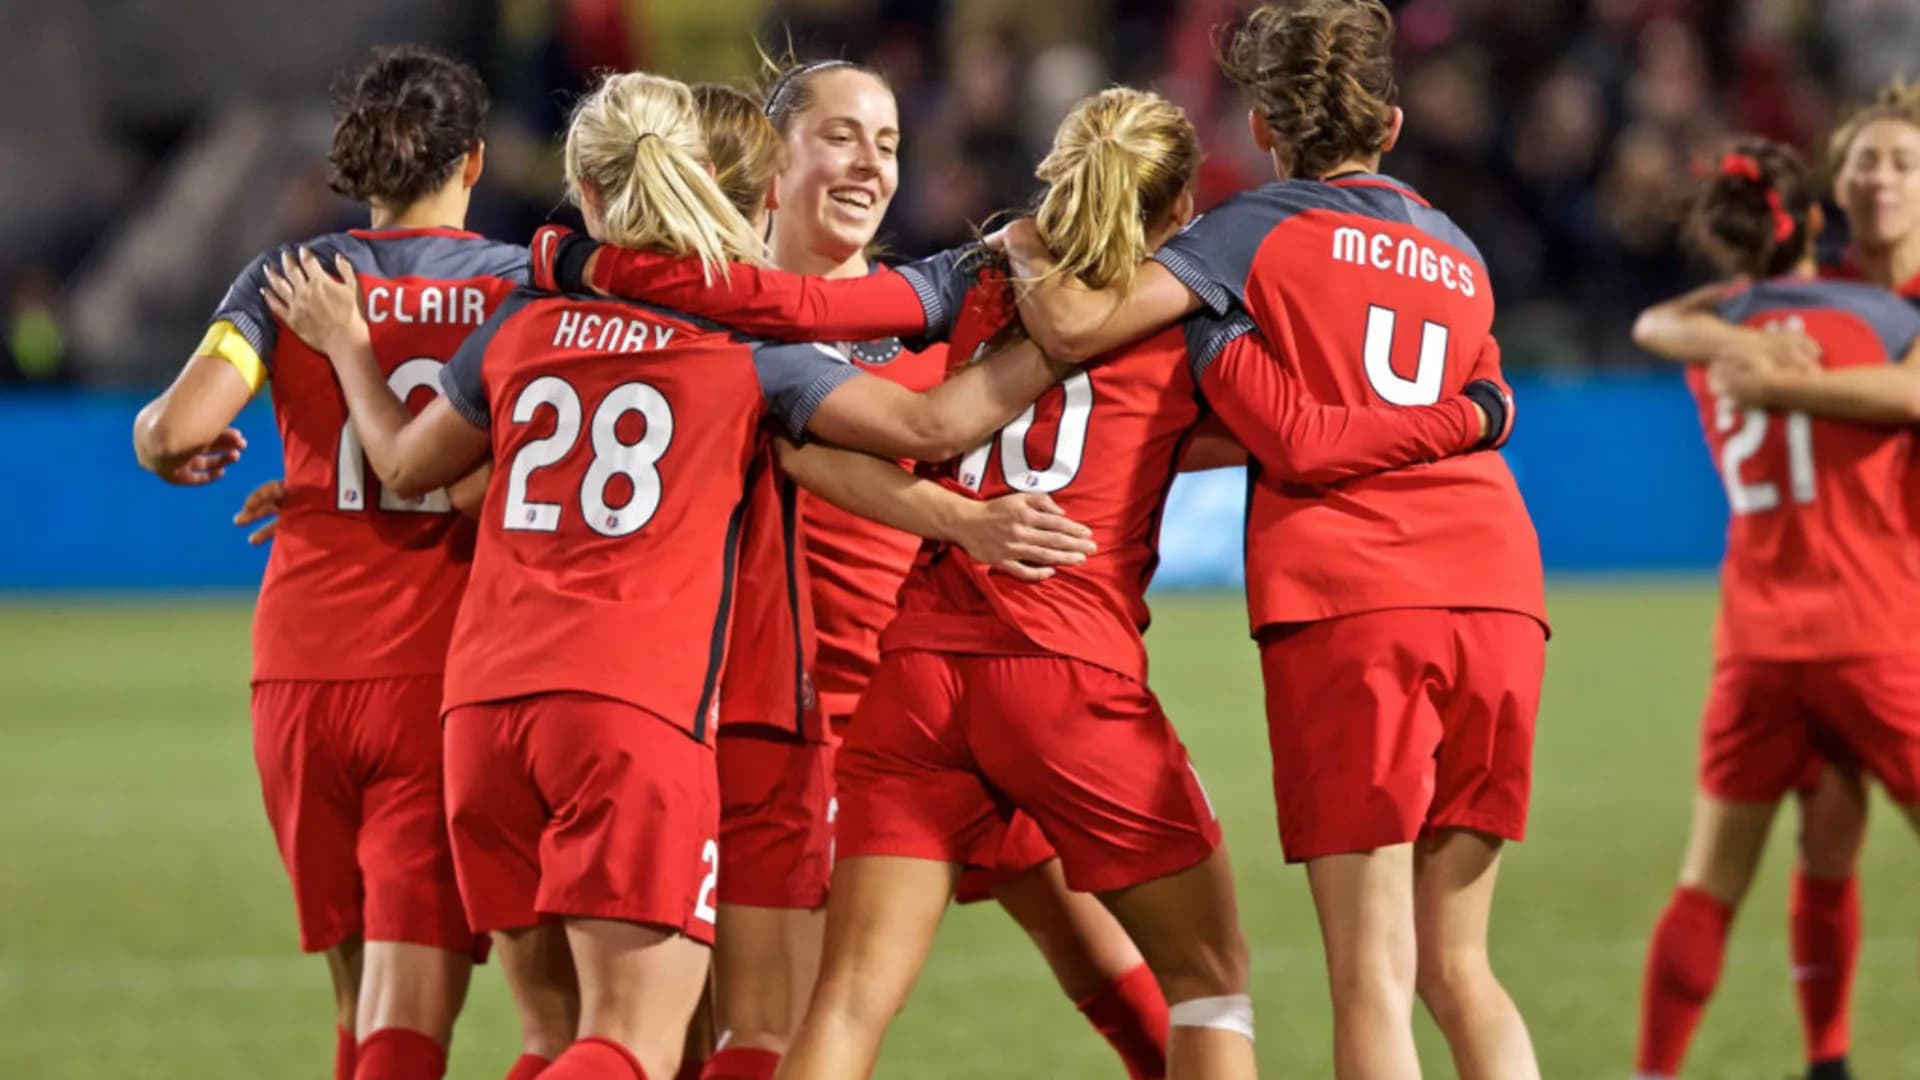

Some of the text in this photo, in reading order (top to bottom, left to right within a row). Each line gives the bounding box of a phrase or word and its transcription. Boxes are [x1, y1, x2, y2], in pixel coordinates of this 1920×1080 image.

[1332, 227, 1475, 297] MENGES
[368, 286, 485, 325] CLAIR
[552, 310, 674, 352] HENRY
[1363, 303, 1448, 406] 4
[503, 376, 674, 537] 28
[1716, 397, 1817, 514] 21
